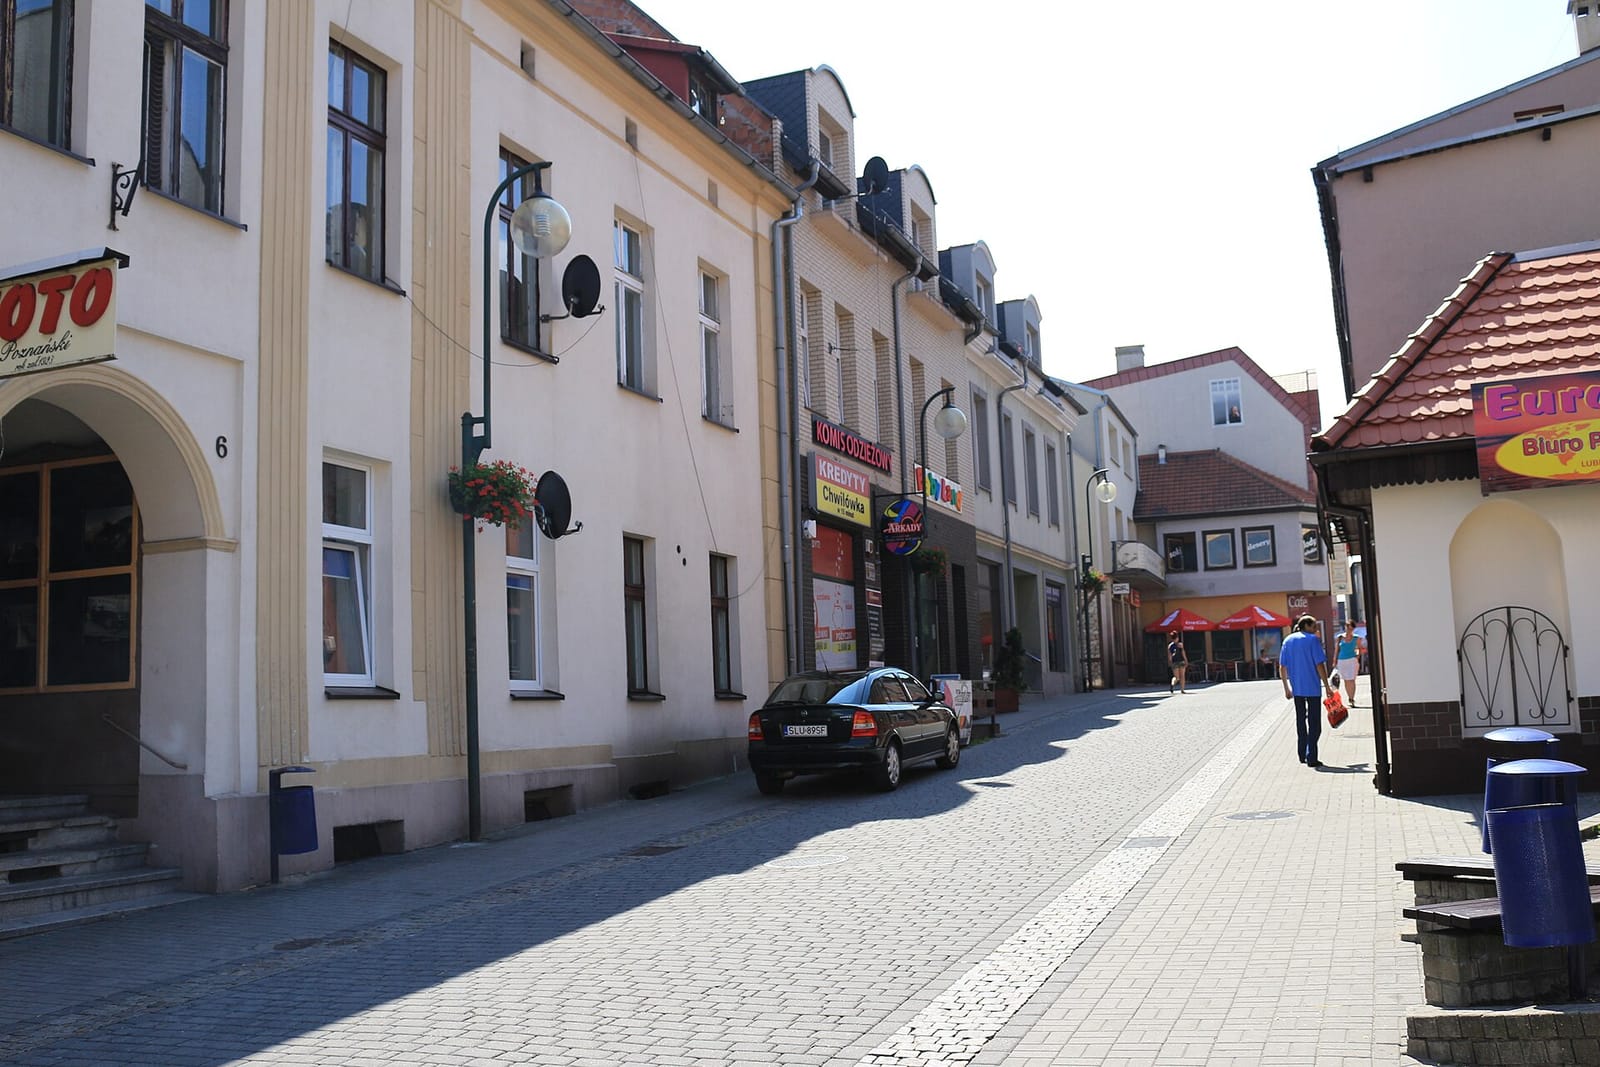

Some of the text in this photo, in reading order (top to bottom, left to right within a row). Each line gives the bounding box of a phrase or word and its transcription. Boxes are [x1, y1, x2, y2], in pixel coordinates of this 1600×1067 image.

[0, 267, 113, 342] OTO
[215, 435, 228, 459] 6
[816, 420, 846, 452] KOMIS
[1522, 437, 1584, 456] Biuro
[819, 459, 866, 493] KREDYTY
[822, 485, 865, 514] Chwilówka
[884, 521, 922, 535] ARKADY
[788, 726, 804, 735] SLU
